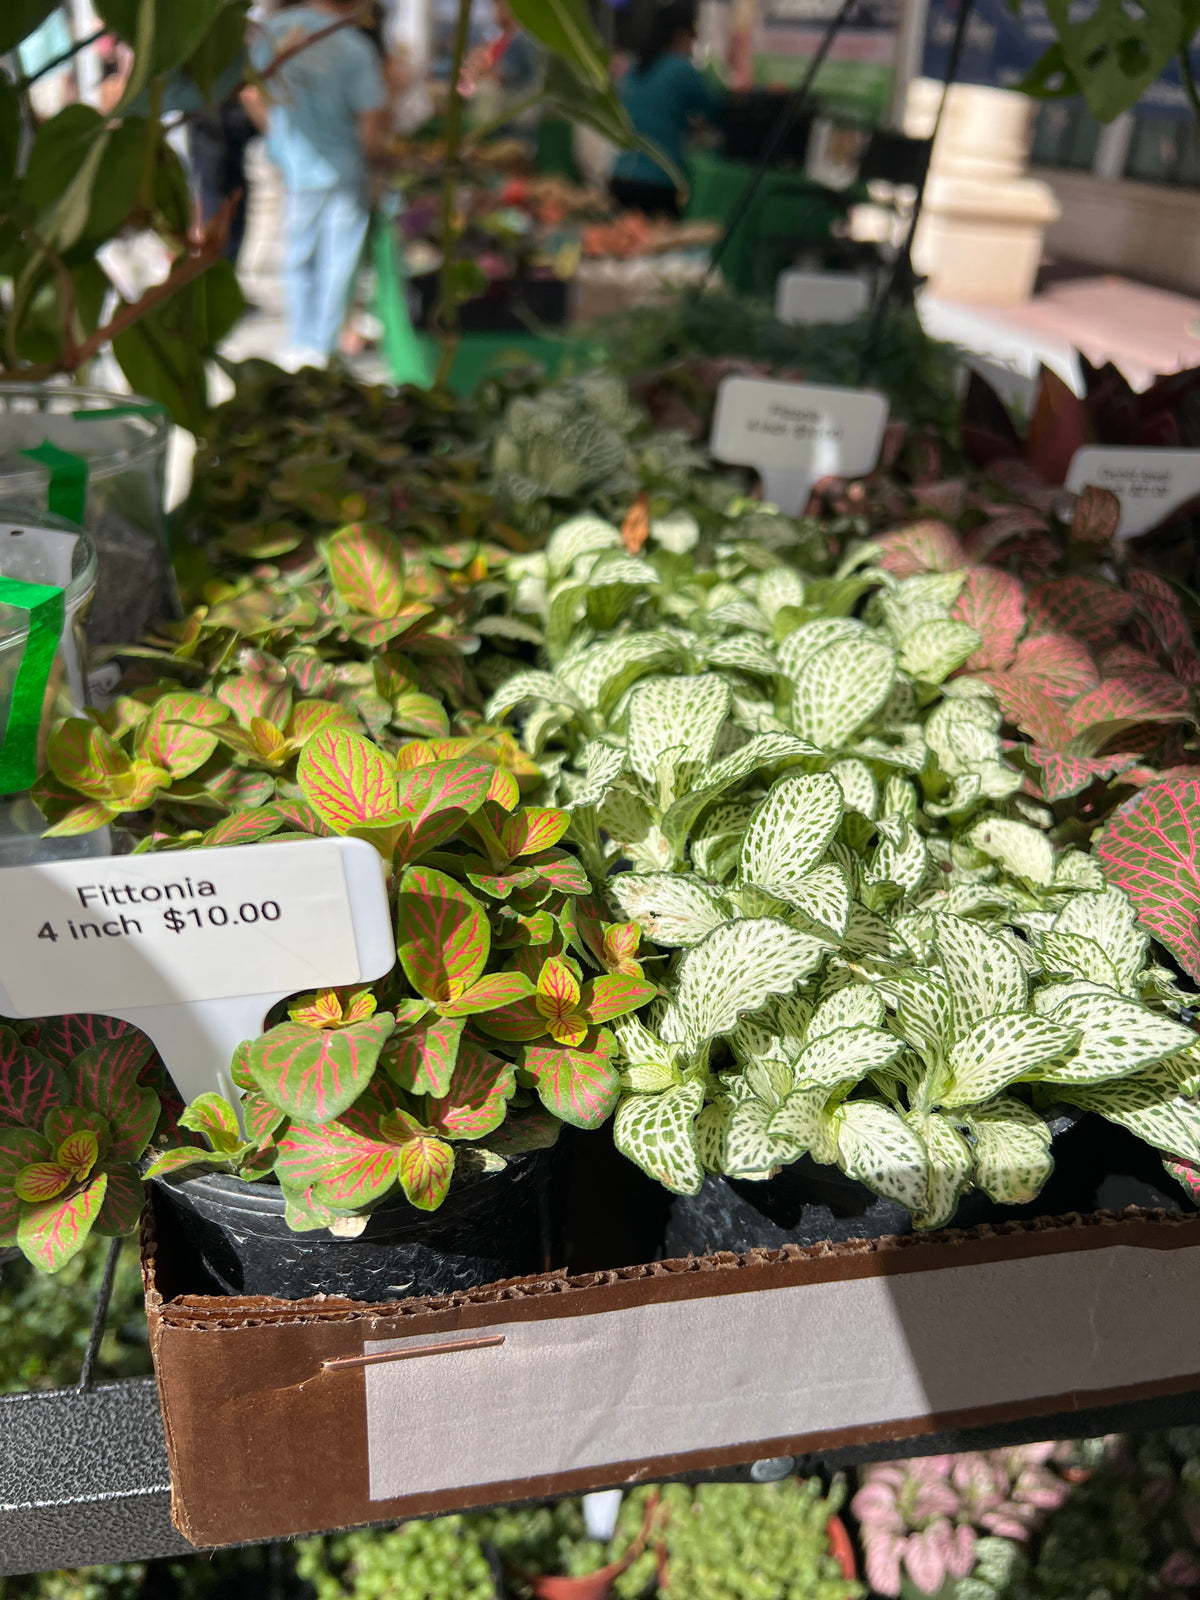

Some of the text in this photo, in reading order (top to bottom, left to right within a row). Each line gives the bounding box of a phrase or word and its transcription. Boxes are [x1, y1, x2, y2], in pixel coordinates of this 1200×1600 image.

[77, 877, 217, 909] Fittonia
[37, 900, 282, 942] 4 inch $10.00
